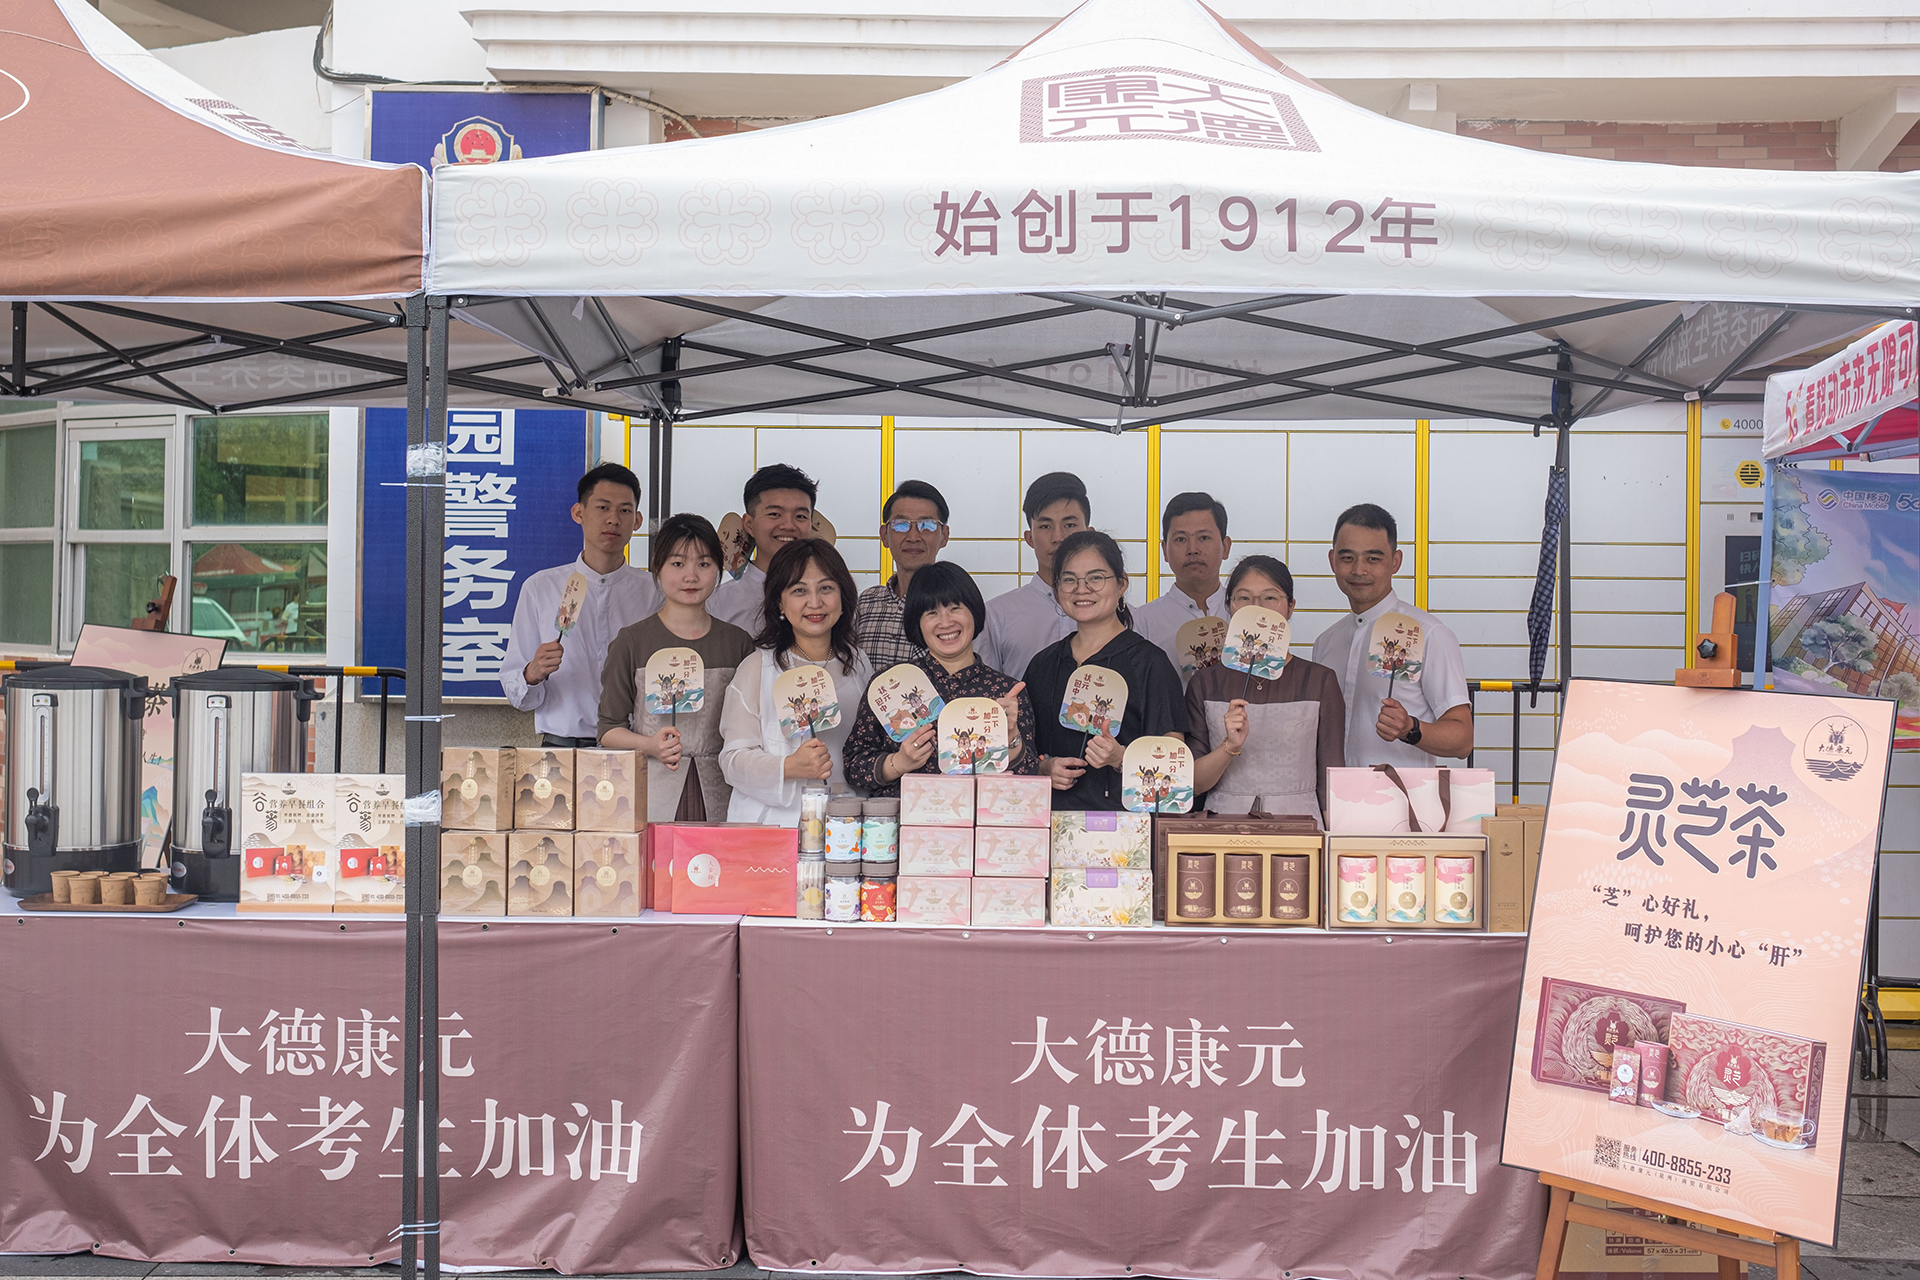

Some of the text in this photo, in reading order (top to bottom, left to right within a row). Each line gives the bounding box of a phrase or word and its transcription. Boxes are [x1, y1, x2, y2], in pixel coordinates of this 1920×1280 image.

[933, 189, 1438, 259] 始创于1912年
[1843, 490, 1890, 503] 中国移动
[1843, 501, 1888, 510] China Mobile
[1072, 679, 1082, 695] 包中
[1081, 673, 1092, 690] 状元
[877, 686, 891, 702] 状元
[983, 712, 991, 733] 加一分
[1169, 752, 1177, 773] 加一分
[1616, 773, 1788, 879] 灵芝茶
[1010, 1016, 1306, 1088] 大德康元
[1723, 1067, 1741, 1087] 灵芝
[839, 1099, 1479, 1196] 为全体考生加油
[1642, 1149, 1731, 1184] 400-8855-233
